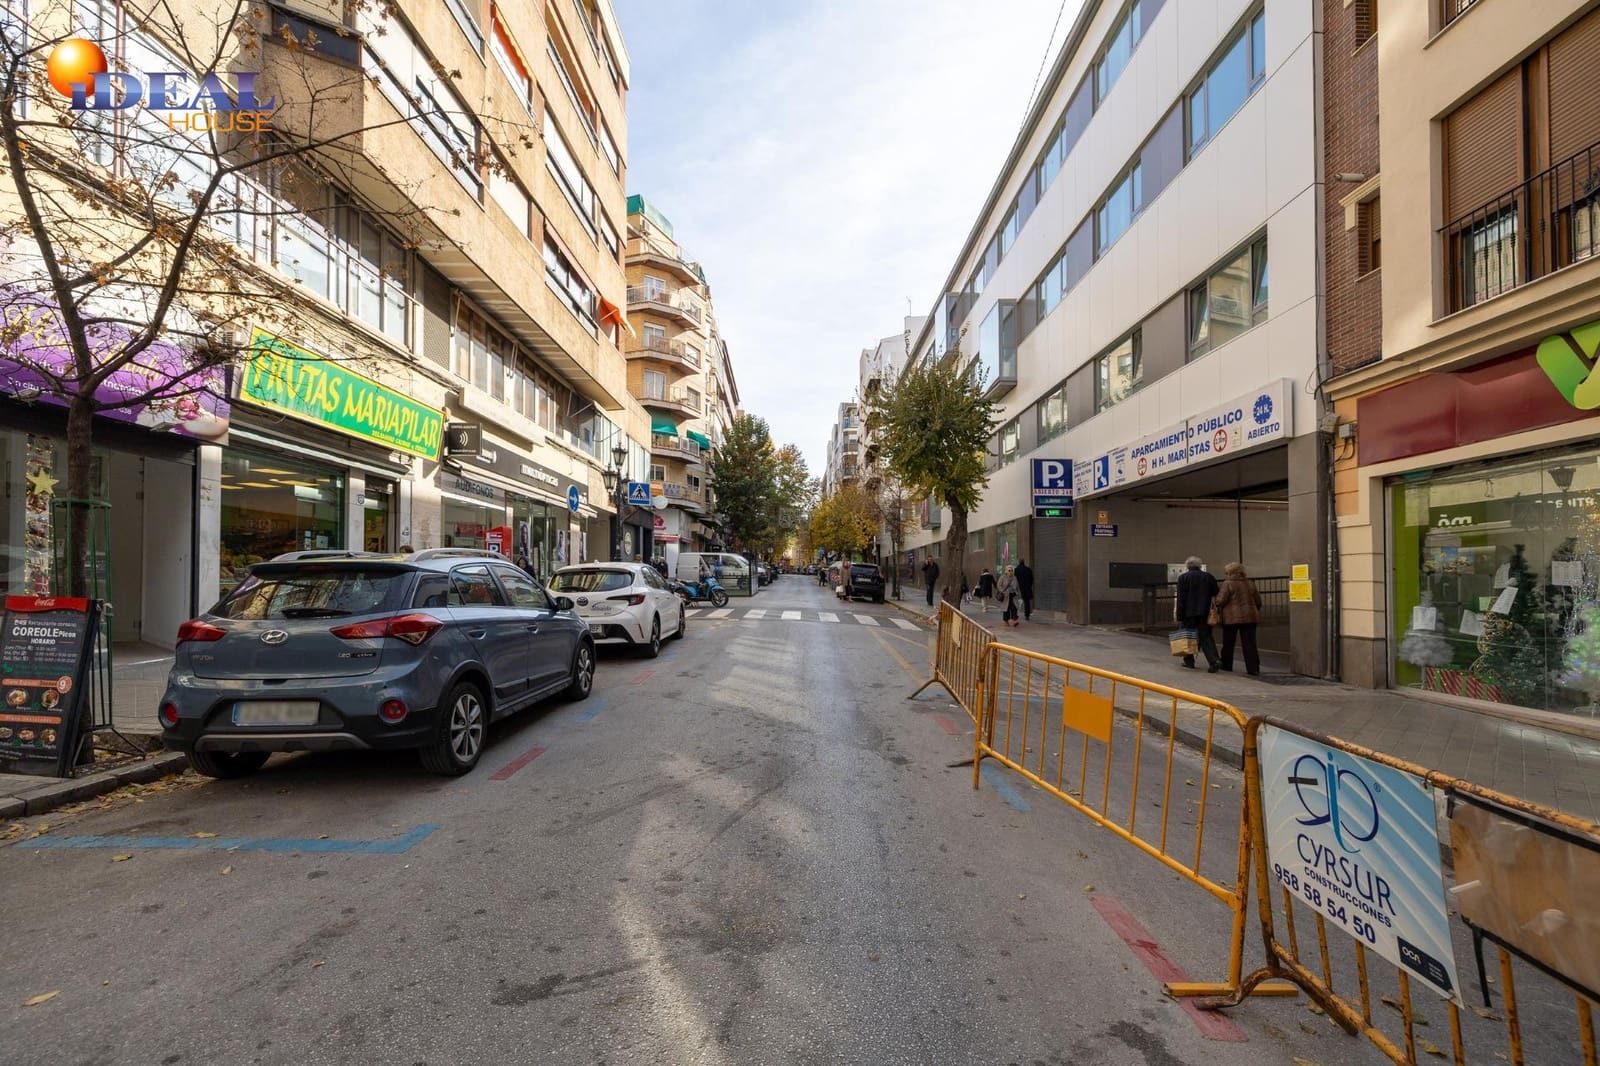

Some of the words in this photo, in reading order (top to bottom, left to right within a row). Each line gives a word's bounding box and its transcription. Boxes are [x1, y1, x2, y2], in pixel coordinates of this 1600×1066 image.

[252, 351, 343, 413] FRUTAS
[342, 383, 439, 449] MARIAPILAR
[1131, 427, 1194, 459] APARCAMIENTO
[1197, 408, 1243, 435] PÚBLICO
[1168, 440, 1210, 463] MARISTAS
[1248, 422, 1280, 440] ABIERTO
[1042, 461, 1064, 487] P
[12, 627, 60, 638] COREOLE
[1296, 833, 1397, 916] CYRSUR
[1303, 866, 1392, 929] CONSTRUCCIONES
[1274, 863, 1300, 893] 958
[1303, 883, 1322, 908] 58
[1327, 900, 1348, 926] 54
[1353, 916, 1376, 945] 50
